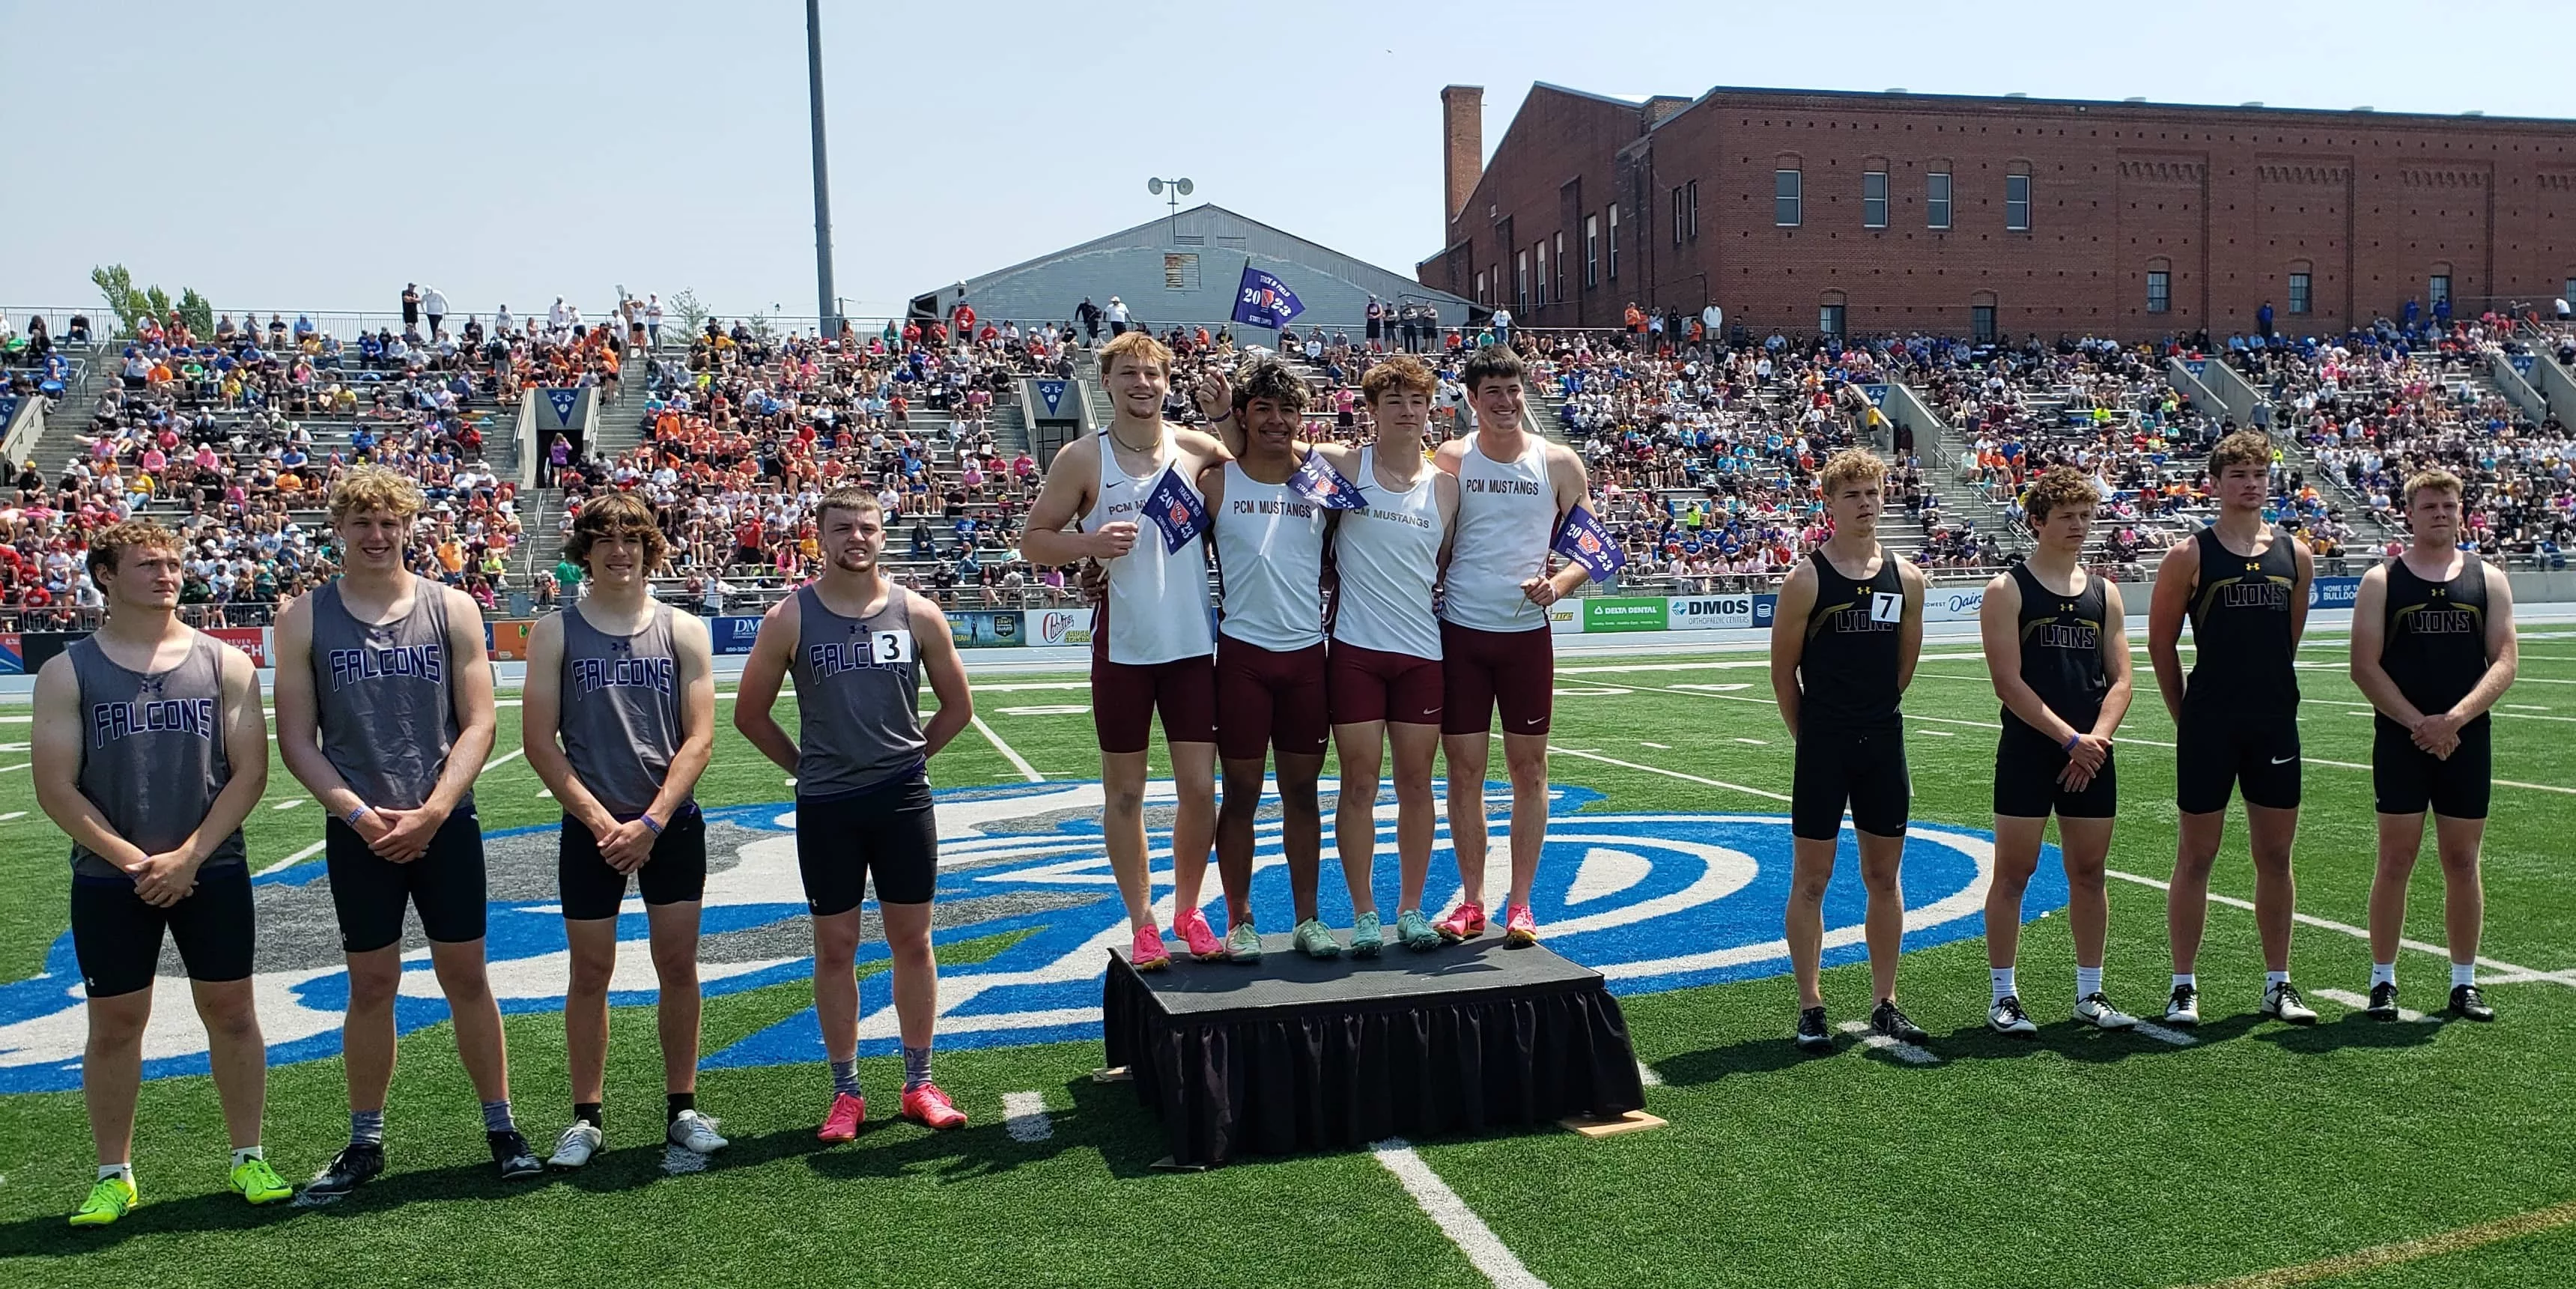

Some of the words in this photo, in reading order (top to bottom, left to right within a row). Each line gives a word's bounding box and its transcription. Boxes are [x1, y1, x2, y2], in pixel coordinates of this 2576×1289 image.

[1243, 288, 1261, 304] 20
[1271, 297, 1292, 316] 23
[1300, 461, 1319, 480] 20
[1466, 479, 1484, 493] PCM
[1489, 479, 1539, 495] MUSTANGS
[1108, 503, 1132, 515] PCM
[1158, 488, 1174, 509] 20
[1180, 521, 1194, 539] 23
[1234, 500, 1254, 515] PCM
[1260, 500, 1311, 518] MUSTANGS
[1373, 509, 1430, 528] MUSTANGS
[1586, 518, 1603, 533] TRACK
[1604, 536, 1617, 551] FIELD
[1567, 524, 1582, 539] 20
[1596, 551, 1613, 571] 23
[1880, 595, 1895, 619] 7
[2224, 583, 2284, 607] LIONS
[1689, 600, 1749, 615] DMOS
[1043, 612, 1075, 643] Cookies
[1689, 616, 1725, 625] ORTHOPAEDIC
[1726, 616, 1749, 624] CENTERS
[2408, 610, 2470, 634] LIONS
[882, 634, 899, 660] 3
[2041, 625, 2095, 649] LIONS
[329, 644, 442, 692] FALCONS
[571, 658, 673, 701] FALCONS
[94, 698, 213, 749] FALCONS
